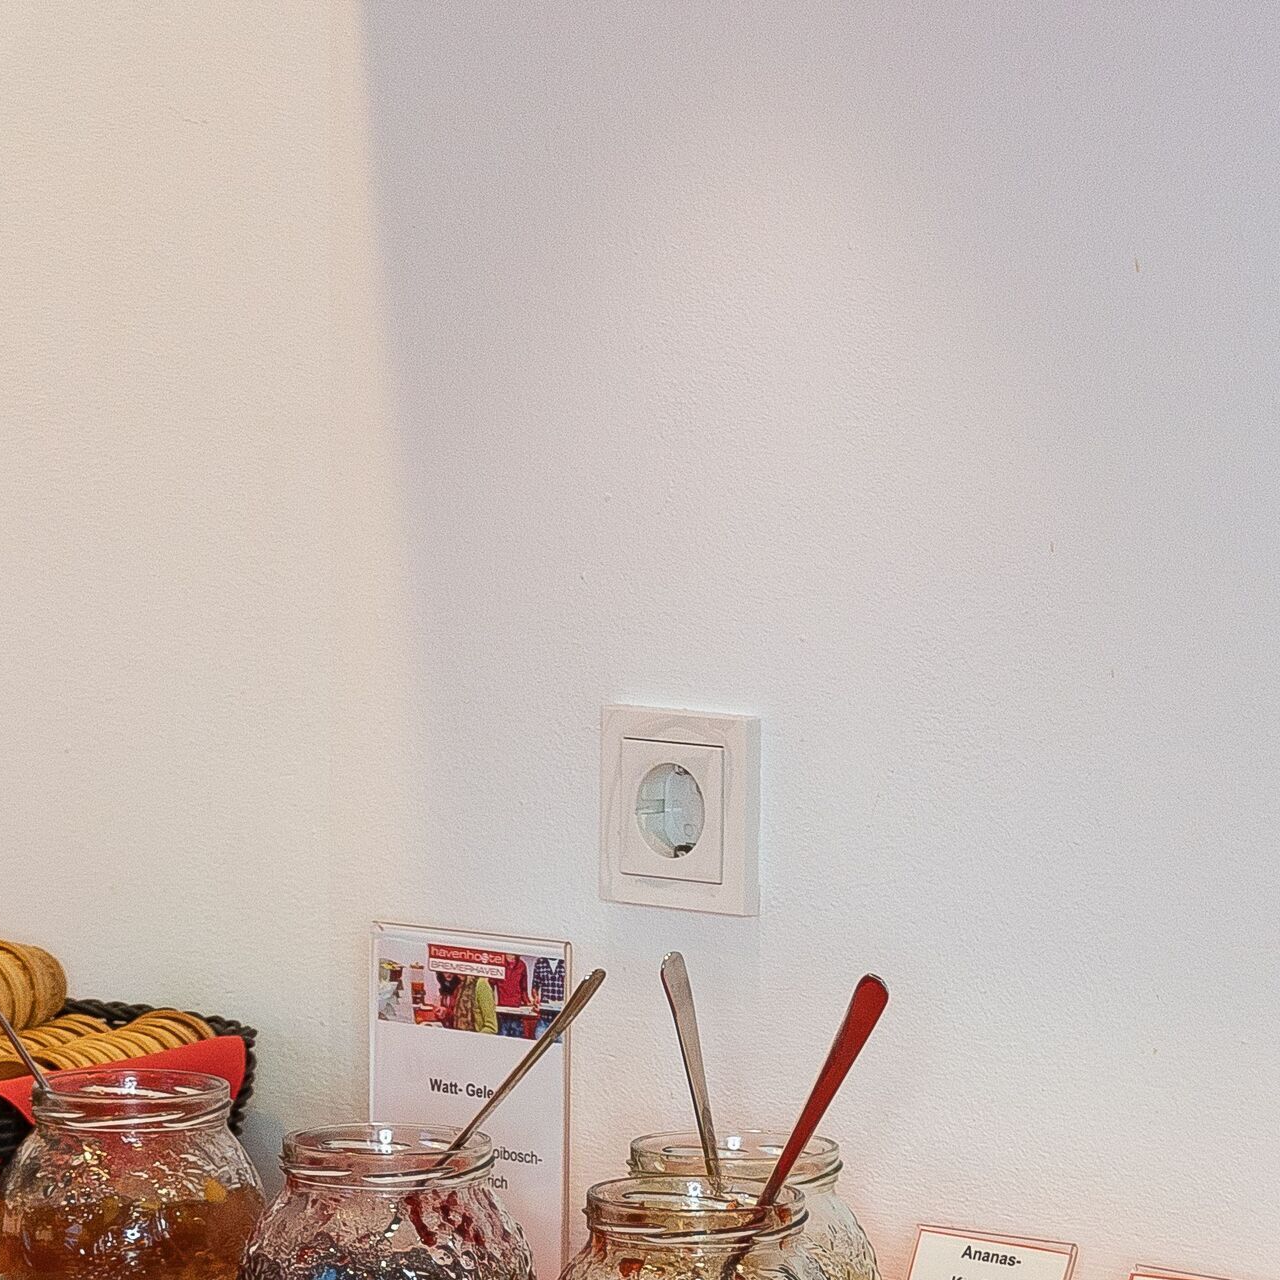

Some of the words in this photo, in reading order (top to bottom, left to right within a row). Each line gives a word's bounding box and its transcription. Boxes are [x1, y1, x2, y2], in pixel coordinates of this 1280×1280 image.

[430, 946, 505, 964] havenhostel
[430, 959, 504, 977] BREMERHAVEN
[430, 1078, 463, 1095] Watt-
[465, 1083, 497, 1099] Gele
[961, 1245, 1022, 1267] Ananas-
